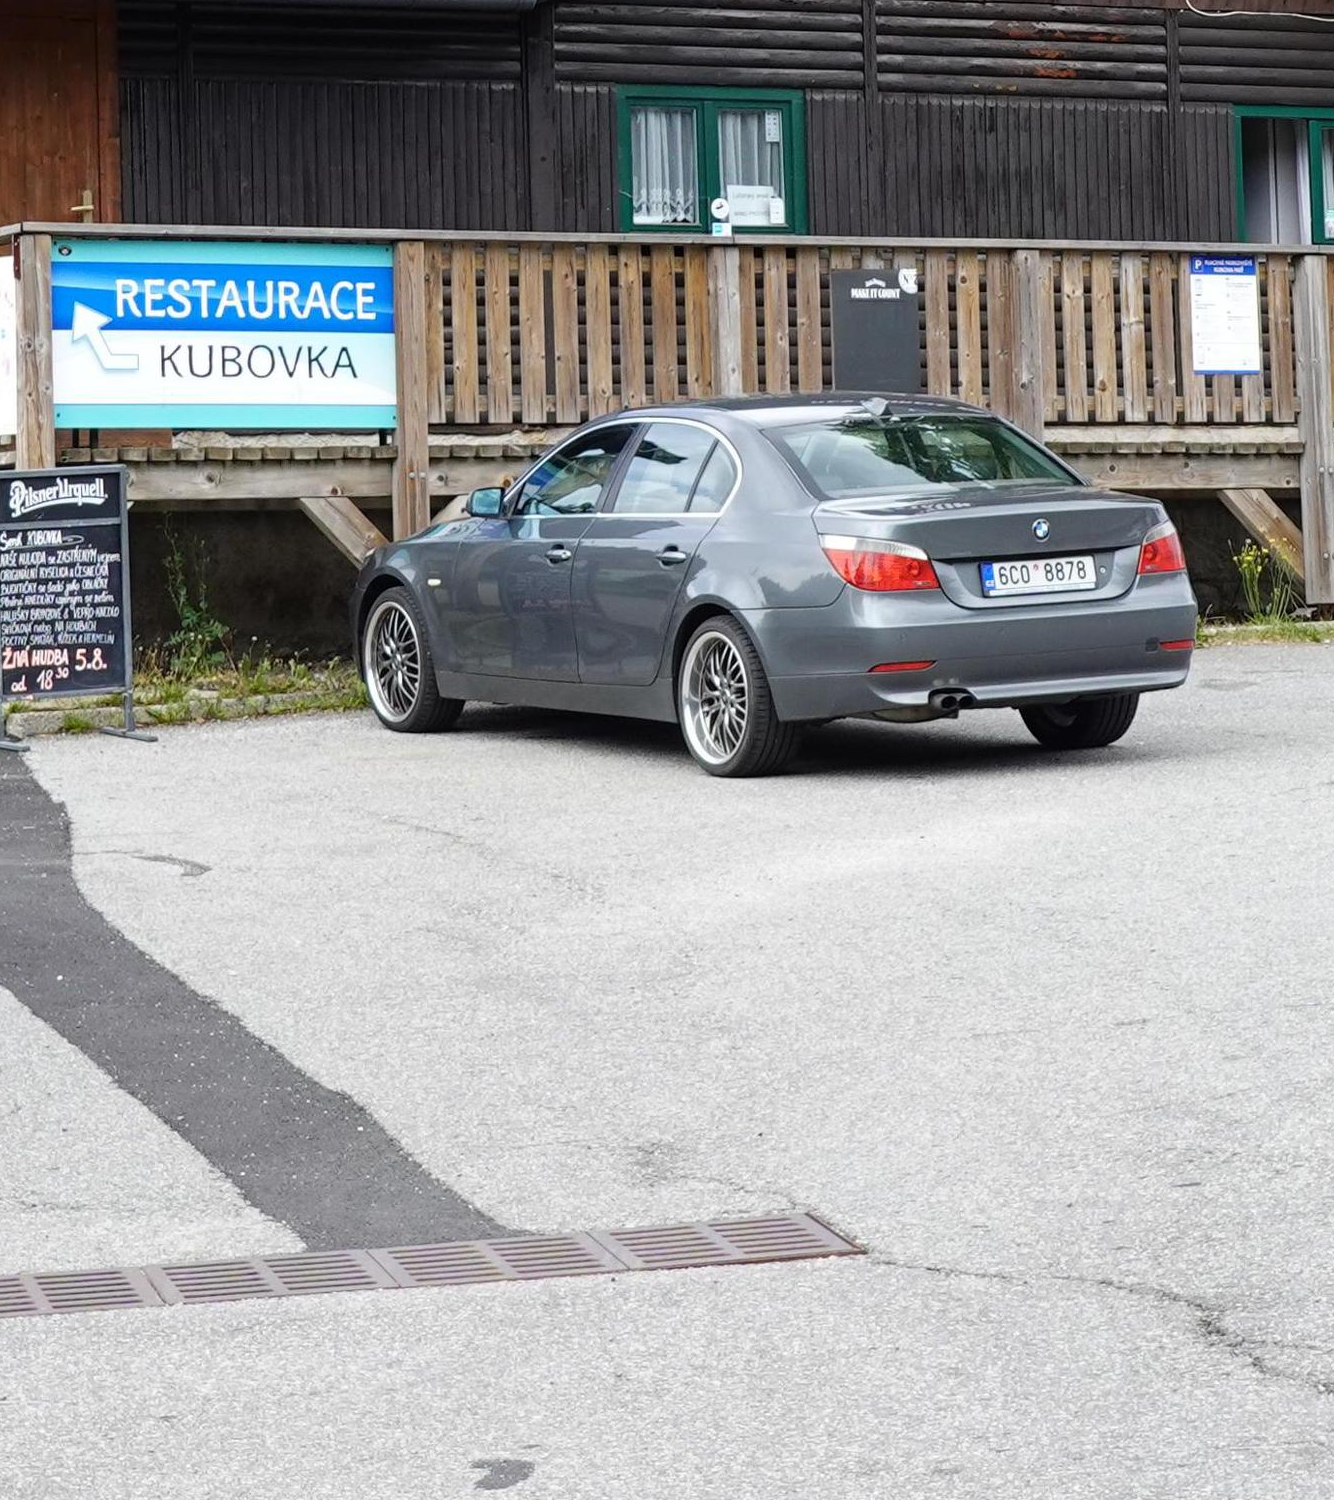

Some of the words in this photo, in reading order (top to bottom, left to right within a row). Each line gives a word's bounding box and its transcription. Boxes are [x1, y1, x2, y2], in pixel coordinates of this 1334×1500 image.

[115, 278, 377, 321] RESTAURACE
[850, 288, 869, 299] MAKE
[870, 288, 877, 299] IT
[878, 288, 901, 299] COUNT
[160, 344, 358, 379] KUBOVKA
[9, 480, 59, 518] Pilsner
[56, 477, 107, 506] Urquell
[1043, 560, 1087, 582] 8878
[2, 645, 30, 670] ŽIVÁ
[31, 647, 69, 667] HUDBA
[74, 647, 108, 671] 5.8.
[10, 674, 28, 692] od
